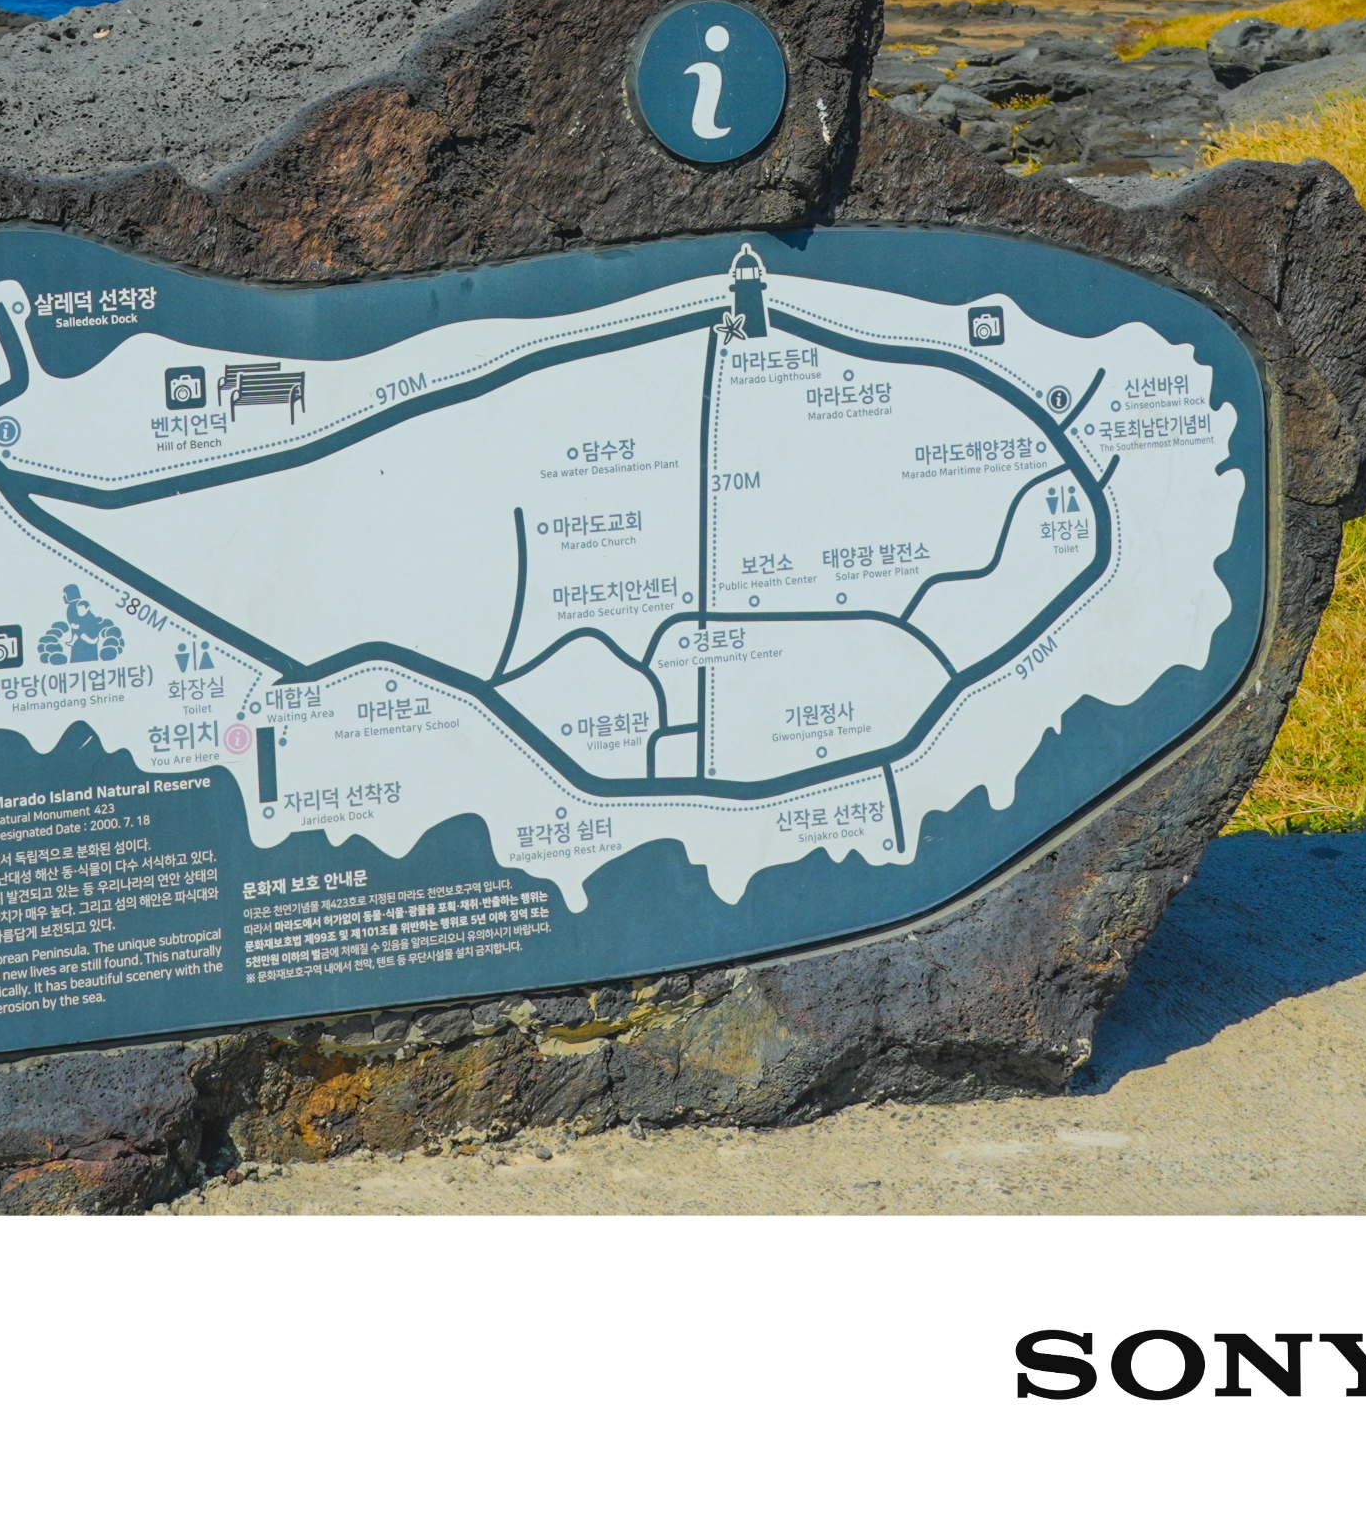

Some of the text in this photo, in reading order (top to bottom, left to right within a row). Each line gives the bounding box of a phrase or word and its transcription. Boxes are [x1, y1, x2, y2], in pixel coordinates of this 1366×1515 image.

[34, 286, 157, 316] 살레덕 선착장
[55, 313, 138, 328] Salledeok Dock
[732, 347, 818, 373] 마라도등대
[375, 372, 427, 405] 970M
[730, 371, 822, 385] Marado Lighthouse
[1125, 374, 1189, 398] 신선바위
[806, 382, 892, 408] 마라도성당
[1125, 396, 1206, 411] Sinseonbawi Rock
[808, 406, 892, 420] Marado Cathedral
[151, 412, 227, 438] 벤치언덕
[1099, 413, 1210, 441] 국토최남단기념비
[157, 438, 222, 452] Hill of Bench
[582, 438, 636, 462] 담수장
[915, 437, 1033, 465] 마라도해양경찰
[1099, 436, 1214, 452] The Southernmost Monument
[540, 460, 679, 479] Sea water Desalination Plant
[901, 460, 1047, 479] Marado Maritime Police Station
[712, 471, 760, 492] 370M
[553, 510, 642, 537] 마라도교회
[1040, 518, 1089, 541] 화장실
[561, 536, 636, 550] Marado Church
[1053, 544, 1079, 554] Toilet
[741, 553, 794, 575] 보건소
[822, 542, 930, 569] 태양광 발전소
[718, 575, 817, 591] Public Health Center
[835, 566, 919, 581] Solar Power Plant
[553, 576, 677, 607] 마라도치안센터
[115, 592, 169, 633] 380M
[557, 602, 675, 620] Marado Security Center
[693, 627, 746, 652] 경로당
[657, 649, 783, 669] Senior Community Center
[1015, 636, 1059, 680] 970M
[168, 675, 224, 701] 화장실
[265, 684, 321, 710] 대합실
[12, 693, 125, 712] Halmangdang Shrine
[182, 704, 212, 715] Toilet
[357, 697, 432, 723] 마라분교
[266, 710, 334, 723] Waiting Area
[577, 711, 649, 738] 마을회관
[785, 701, 854, 727] 기원정사
[148, 720, 219, 753] 현위치
[335, 718, 460, 739] Mara Elementary School
[772, 724, 871, 742] Giwonjungsa Temple
[586, 736, 642, 751] Village Hall
[150, 752, 220, 766] You Are Here
[50, 786, 93, 803] Island
[97, 781, 150, 799] Natural
[154, 777, 211, 793] Reserve
[284, 781, 401, 813] 자리덕 선착장
[33, 806, 91, 821] Monument
[94, 803, 115, 814] 423
[301, 809, 374, 826] Jarideok Dock
[776, 800, 885, 832] 신작로 선착장
[55, 823, 81, 835] Date
[90, 818, 121, 831] 2000.
[123, 816, 134, 827] 7.
[136, 814, 150, 826] 18
[517, 817, 612, 848] 팔각정 쉼터
[798, 827, 865, 844] Sinjakro Dock
[14, 846, 74, 865] 독립적으로
[76, 841, 111, 859] 분화된
[114, 837, 151, 855] 섬이다.
[509, 843, 622, 863] Palgakjeong Rest Area
[242, 869, 368, 900] 문화재 보호 안내문
